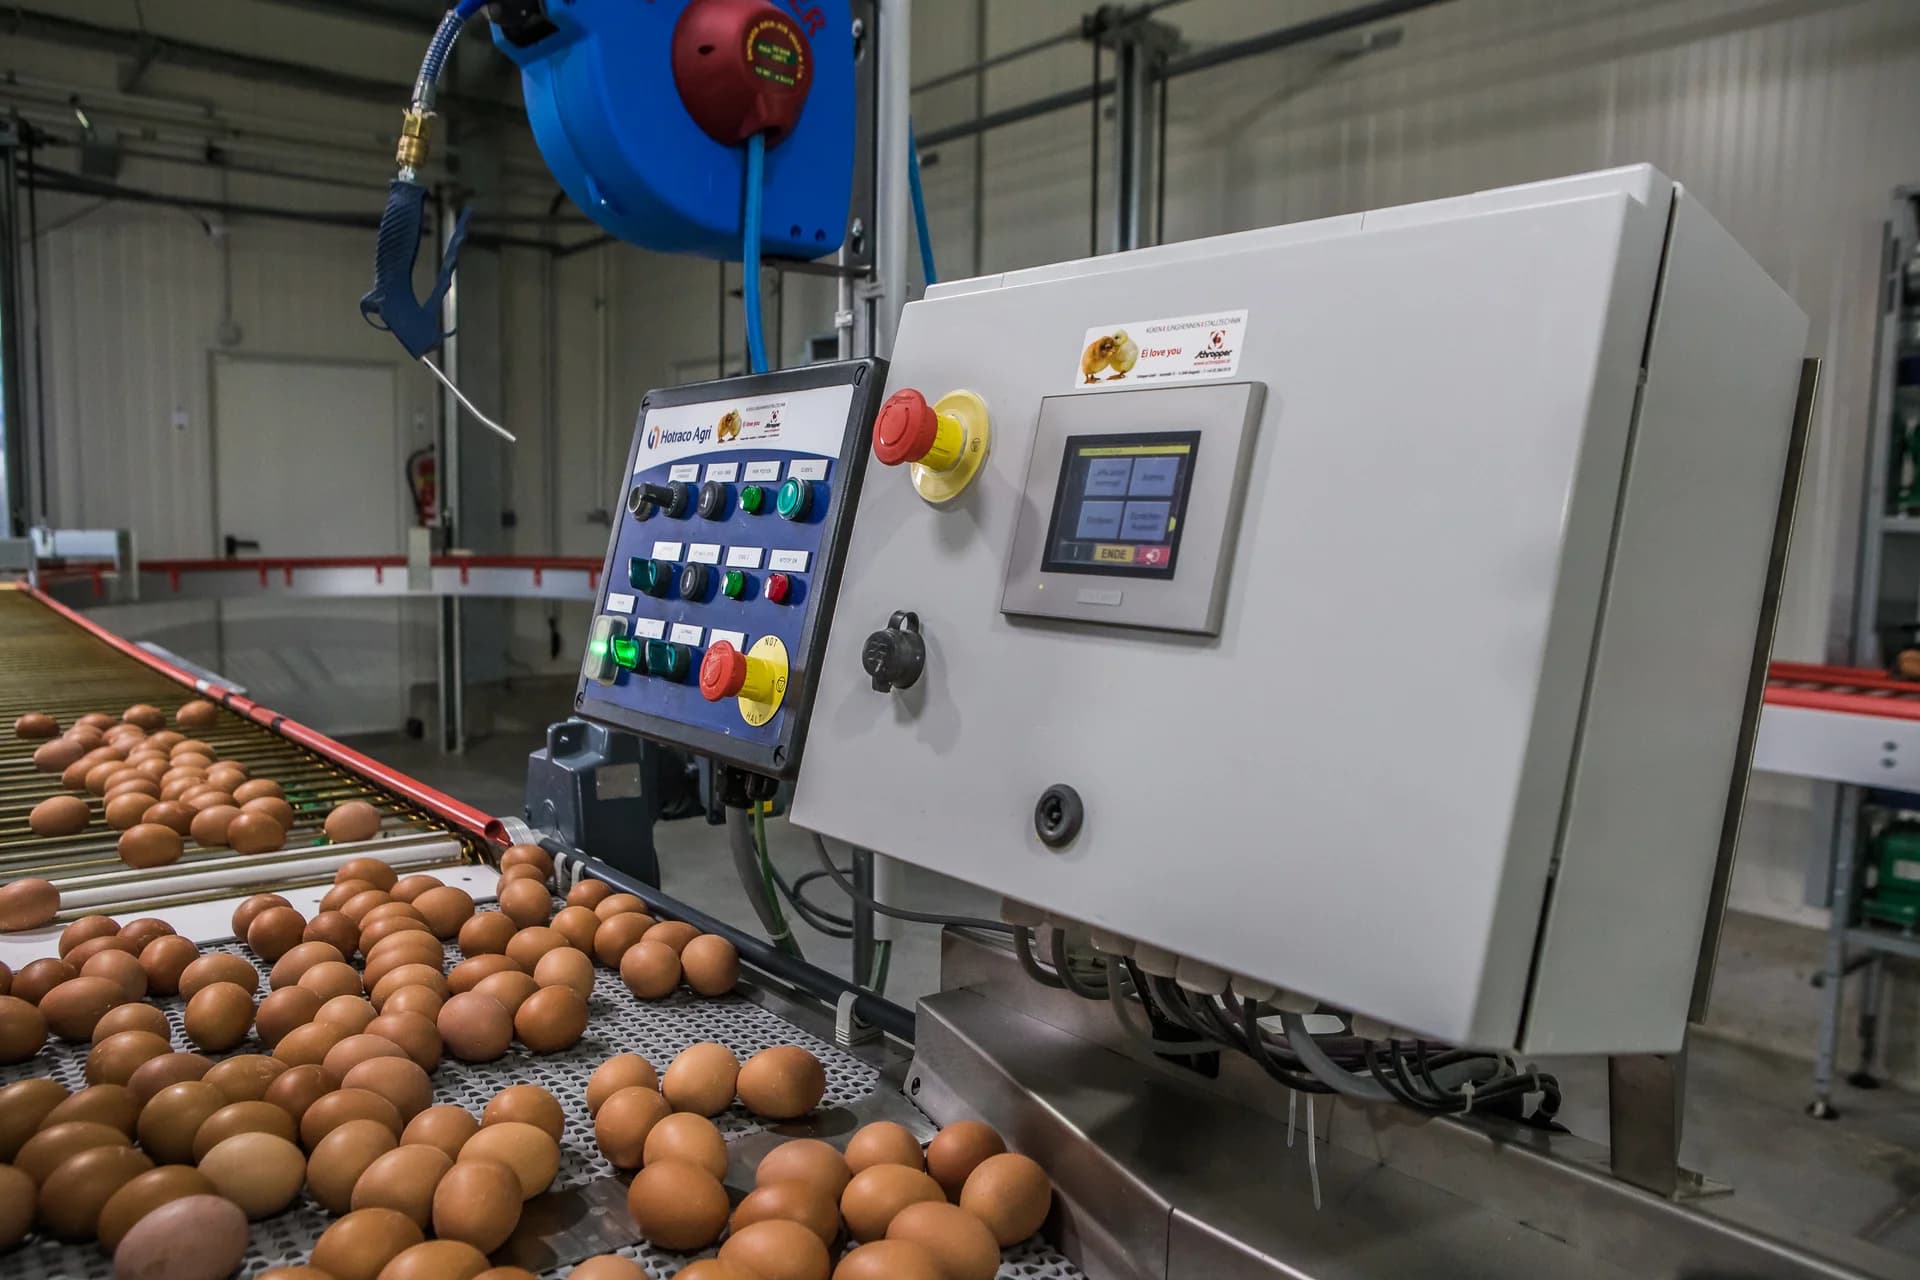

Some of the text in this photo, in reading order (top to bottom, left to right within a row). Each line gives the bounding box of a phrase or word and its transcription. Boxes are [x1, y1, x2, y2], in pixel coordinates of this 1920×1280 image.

[1150, 348, 1166, 357] love
[1167, 347, 1182, 358] you
[660, 425, 713, 445] Hotraco Agri
[1101, 548, 1127, 560] ENDE
[765, 637, 778, 648] NOT
